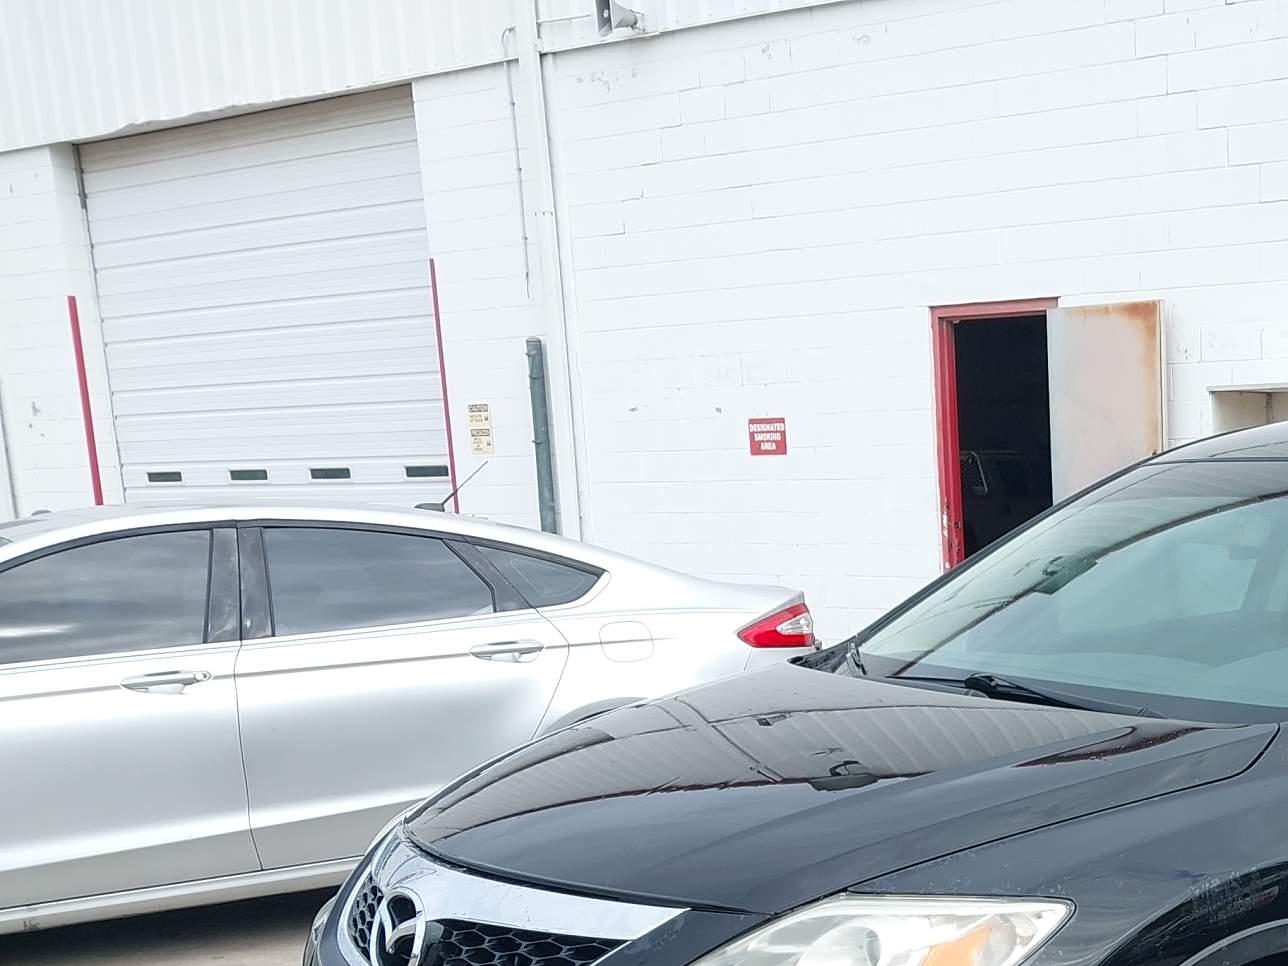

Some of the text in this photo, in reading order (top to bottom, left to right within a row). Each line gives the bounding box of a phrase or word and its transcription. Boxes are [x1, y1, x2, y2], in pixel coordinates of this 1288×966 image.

[749, 423, 785, 432] DESIGNATED
[754, 433, 782, 441] SMOKING
[760, 442, 777, 450] AREA
